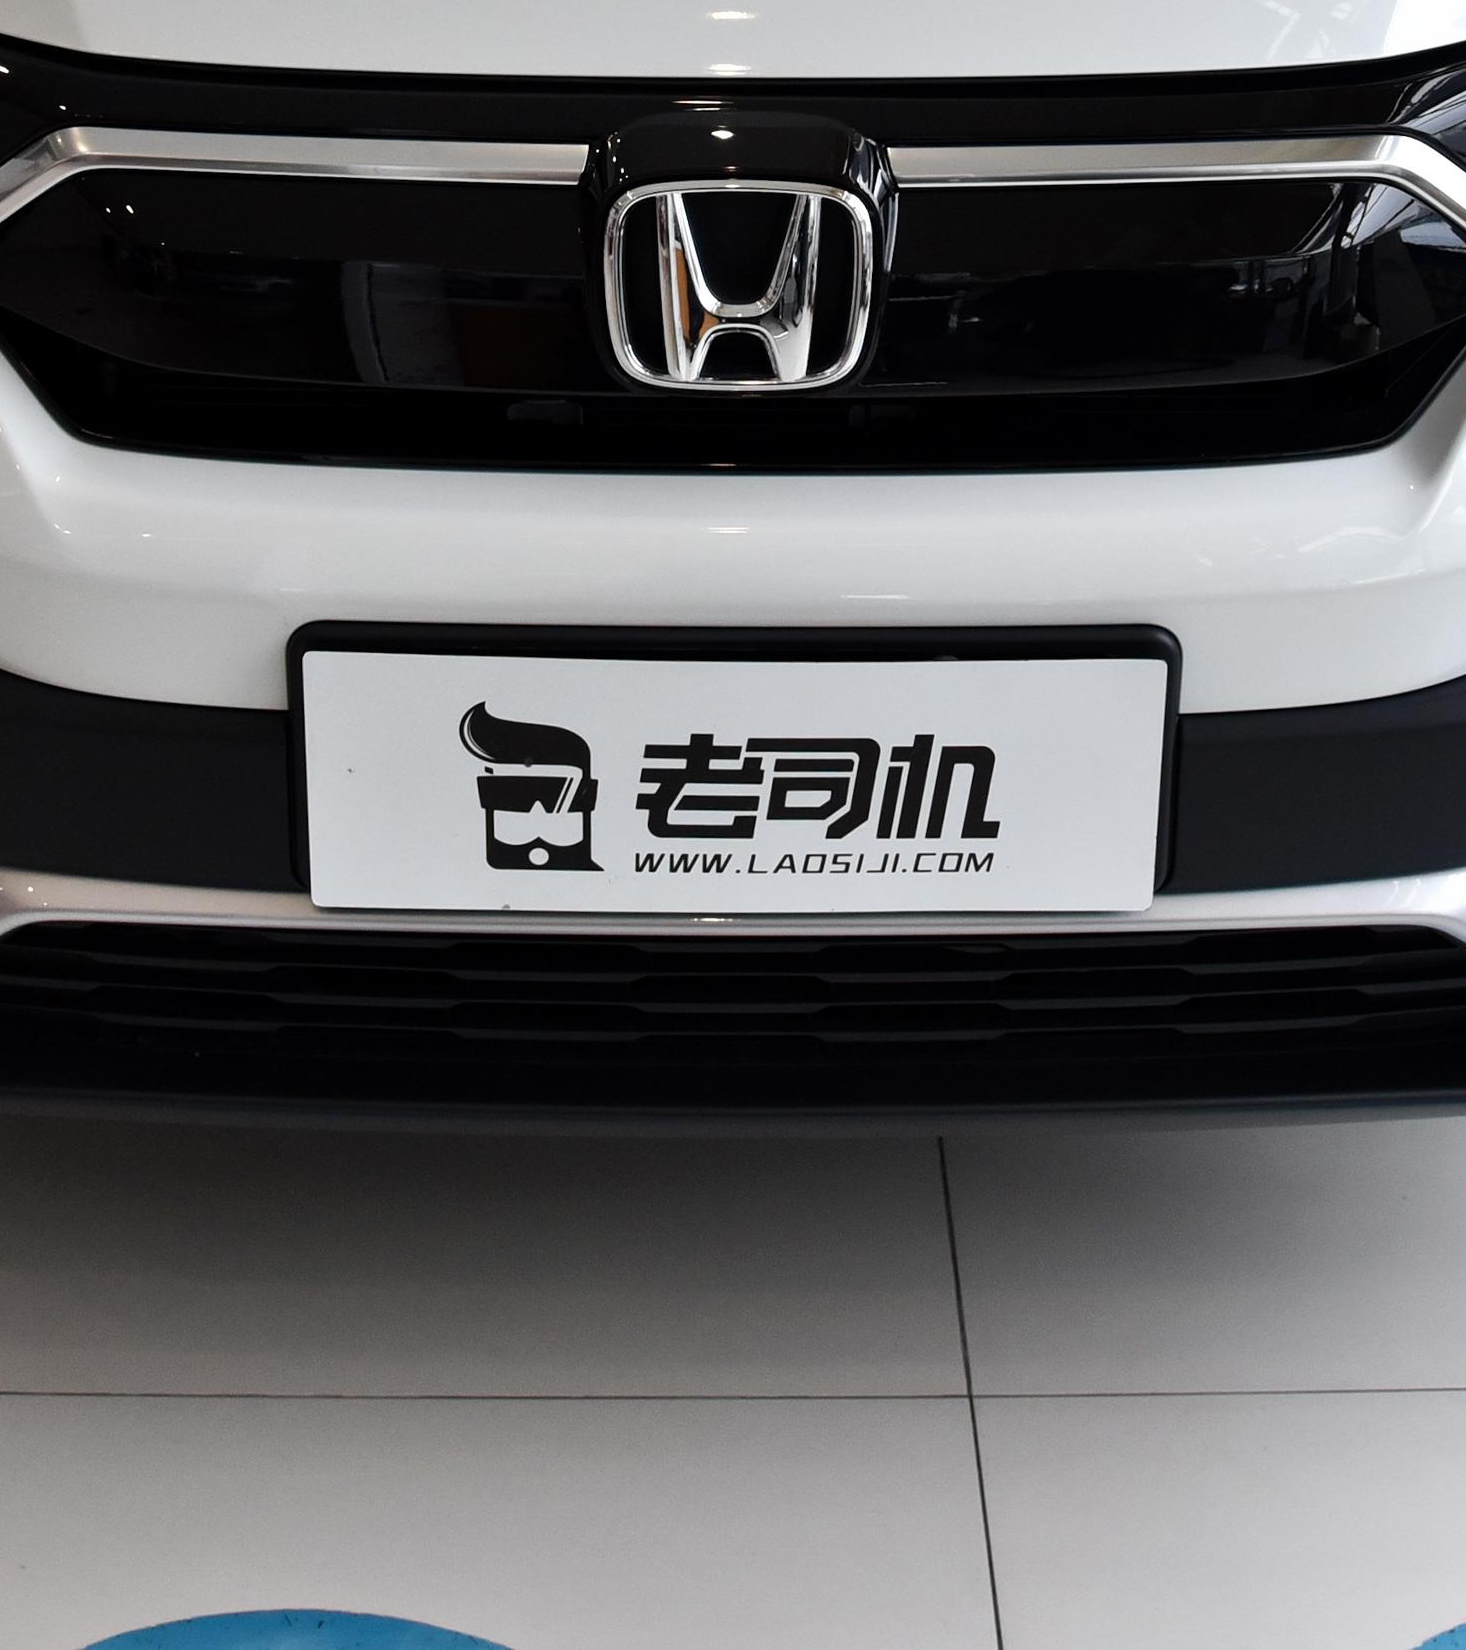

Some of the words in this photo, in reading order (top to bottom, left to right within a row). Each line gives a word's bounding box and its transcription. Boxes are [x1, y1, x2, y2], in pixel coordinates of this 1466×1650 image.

[634, 733, 1001, 840] 老司机
[633, 851, 995, 876] WWW.LAOSIJI.COM
